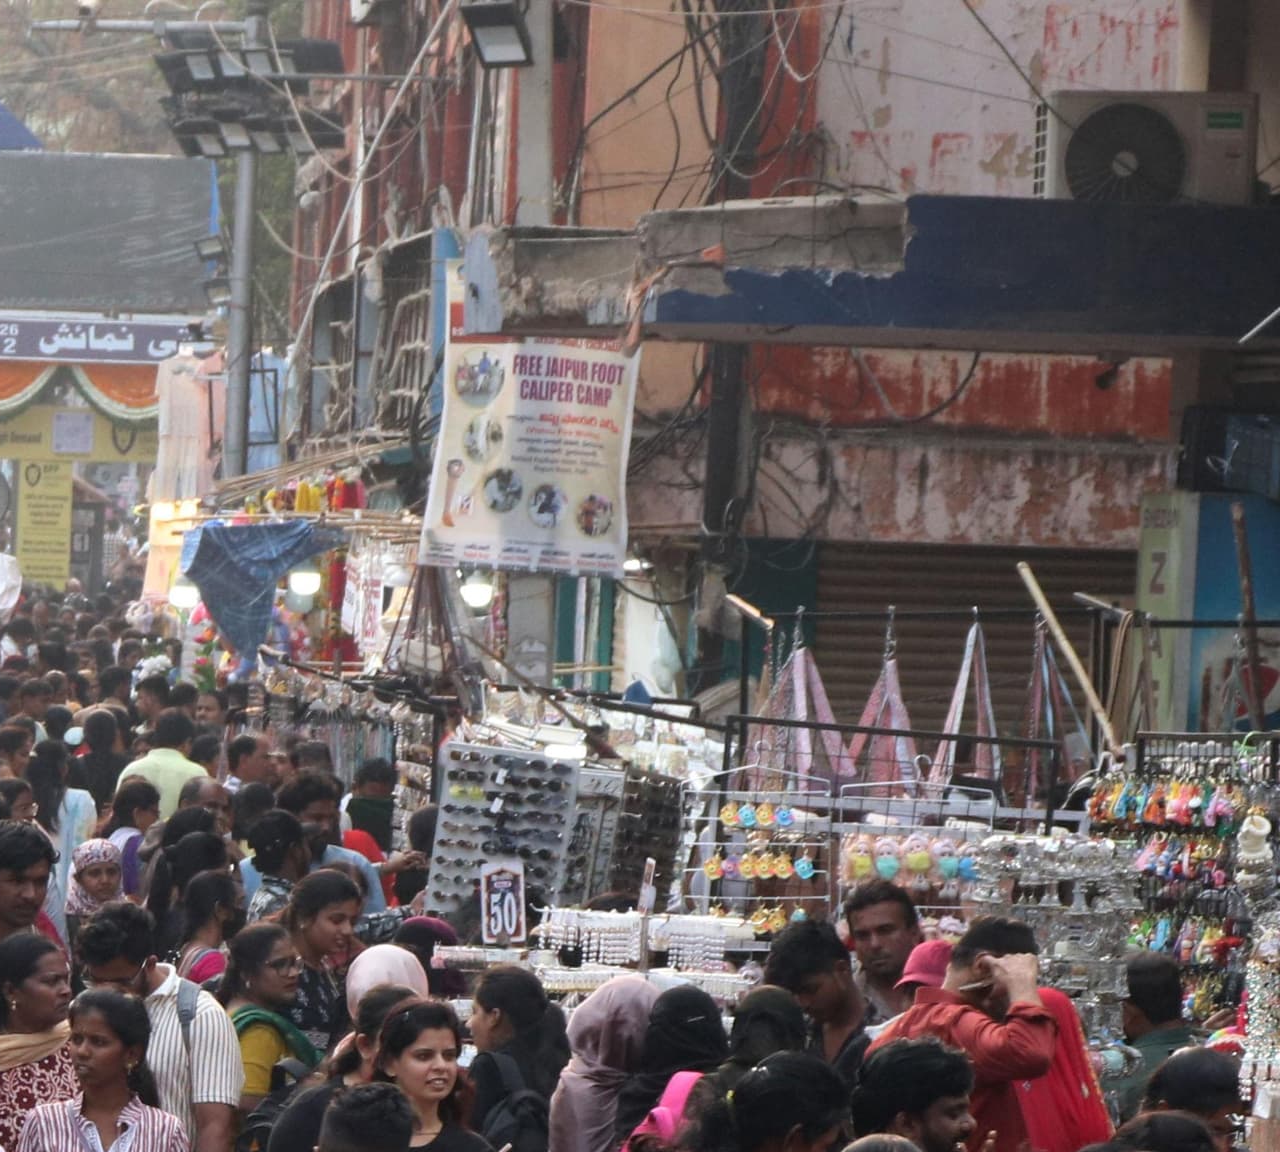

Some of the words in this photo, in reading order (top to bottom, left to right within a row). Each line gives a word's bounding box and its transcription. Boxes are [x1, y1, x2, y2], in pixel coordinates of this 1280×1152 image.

[2, 338, 17, 354] 2
[39, 323, 135, 355] نمائش
[512, 354, 543, 376] FREE
[546, 357, 588, 379] JAIPUR
[591, 363, 625, 385] FOOT
[520, 379, 572, 404] CALIPER
[576, 384, 612, 407] CAMP
[490, 892, 517, 936] 50
